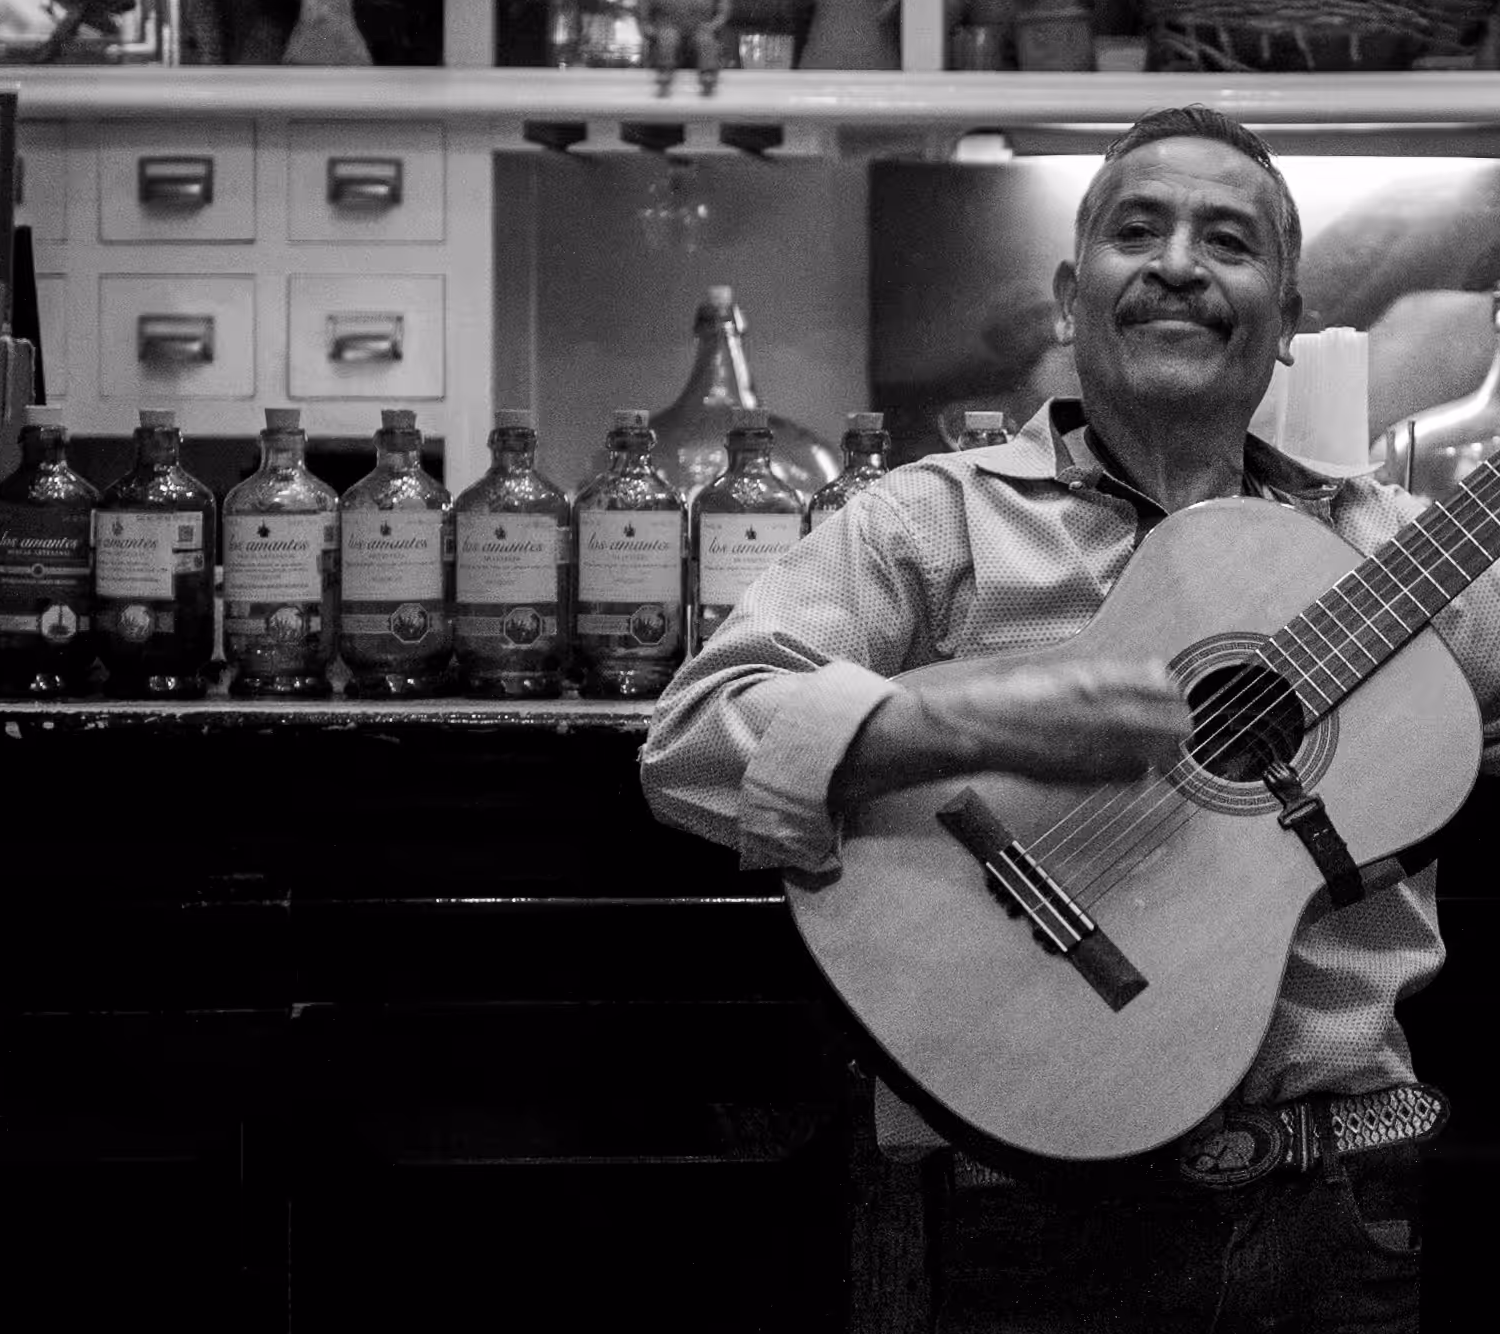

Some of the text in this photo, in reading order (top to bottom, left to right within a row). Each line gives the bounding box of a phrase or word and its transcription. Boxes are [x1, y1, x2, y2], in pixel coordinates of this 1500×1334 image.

[0, 530, 79, 550] los amantes
[103, 536, 157, 550] amantes
[245, 537, 309, 552] amantes
[367, 537, 427, 550] amantes
[482, 539, 543, 553] amantes
[589, 532, 670, 551] los amantes
[708, 536, 727, 554] los
